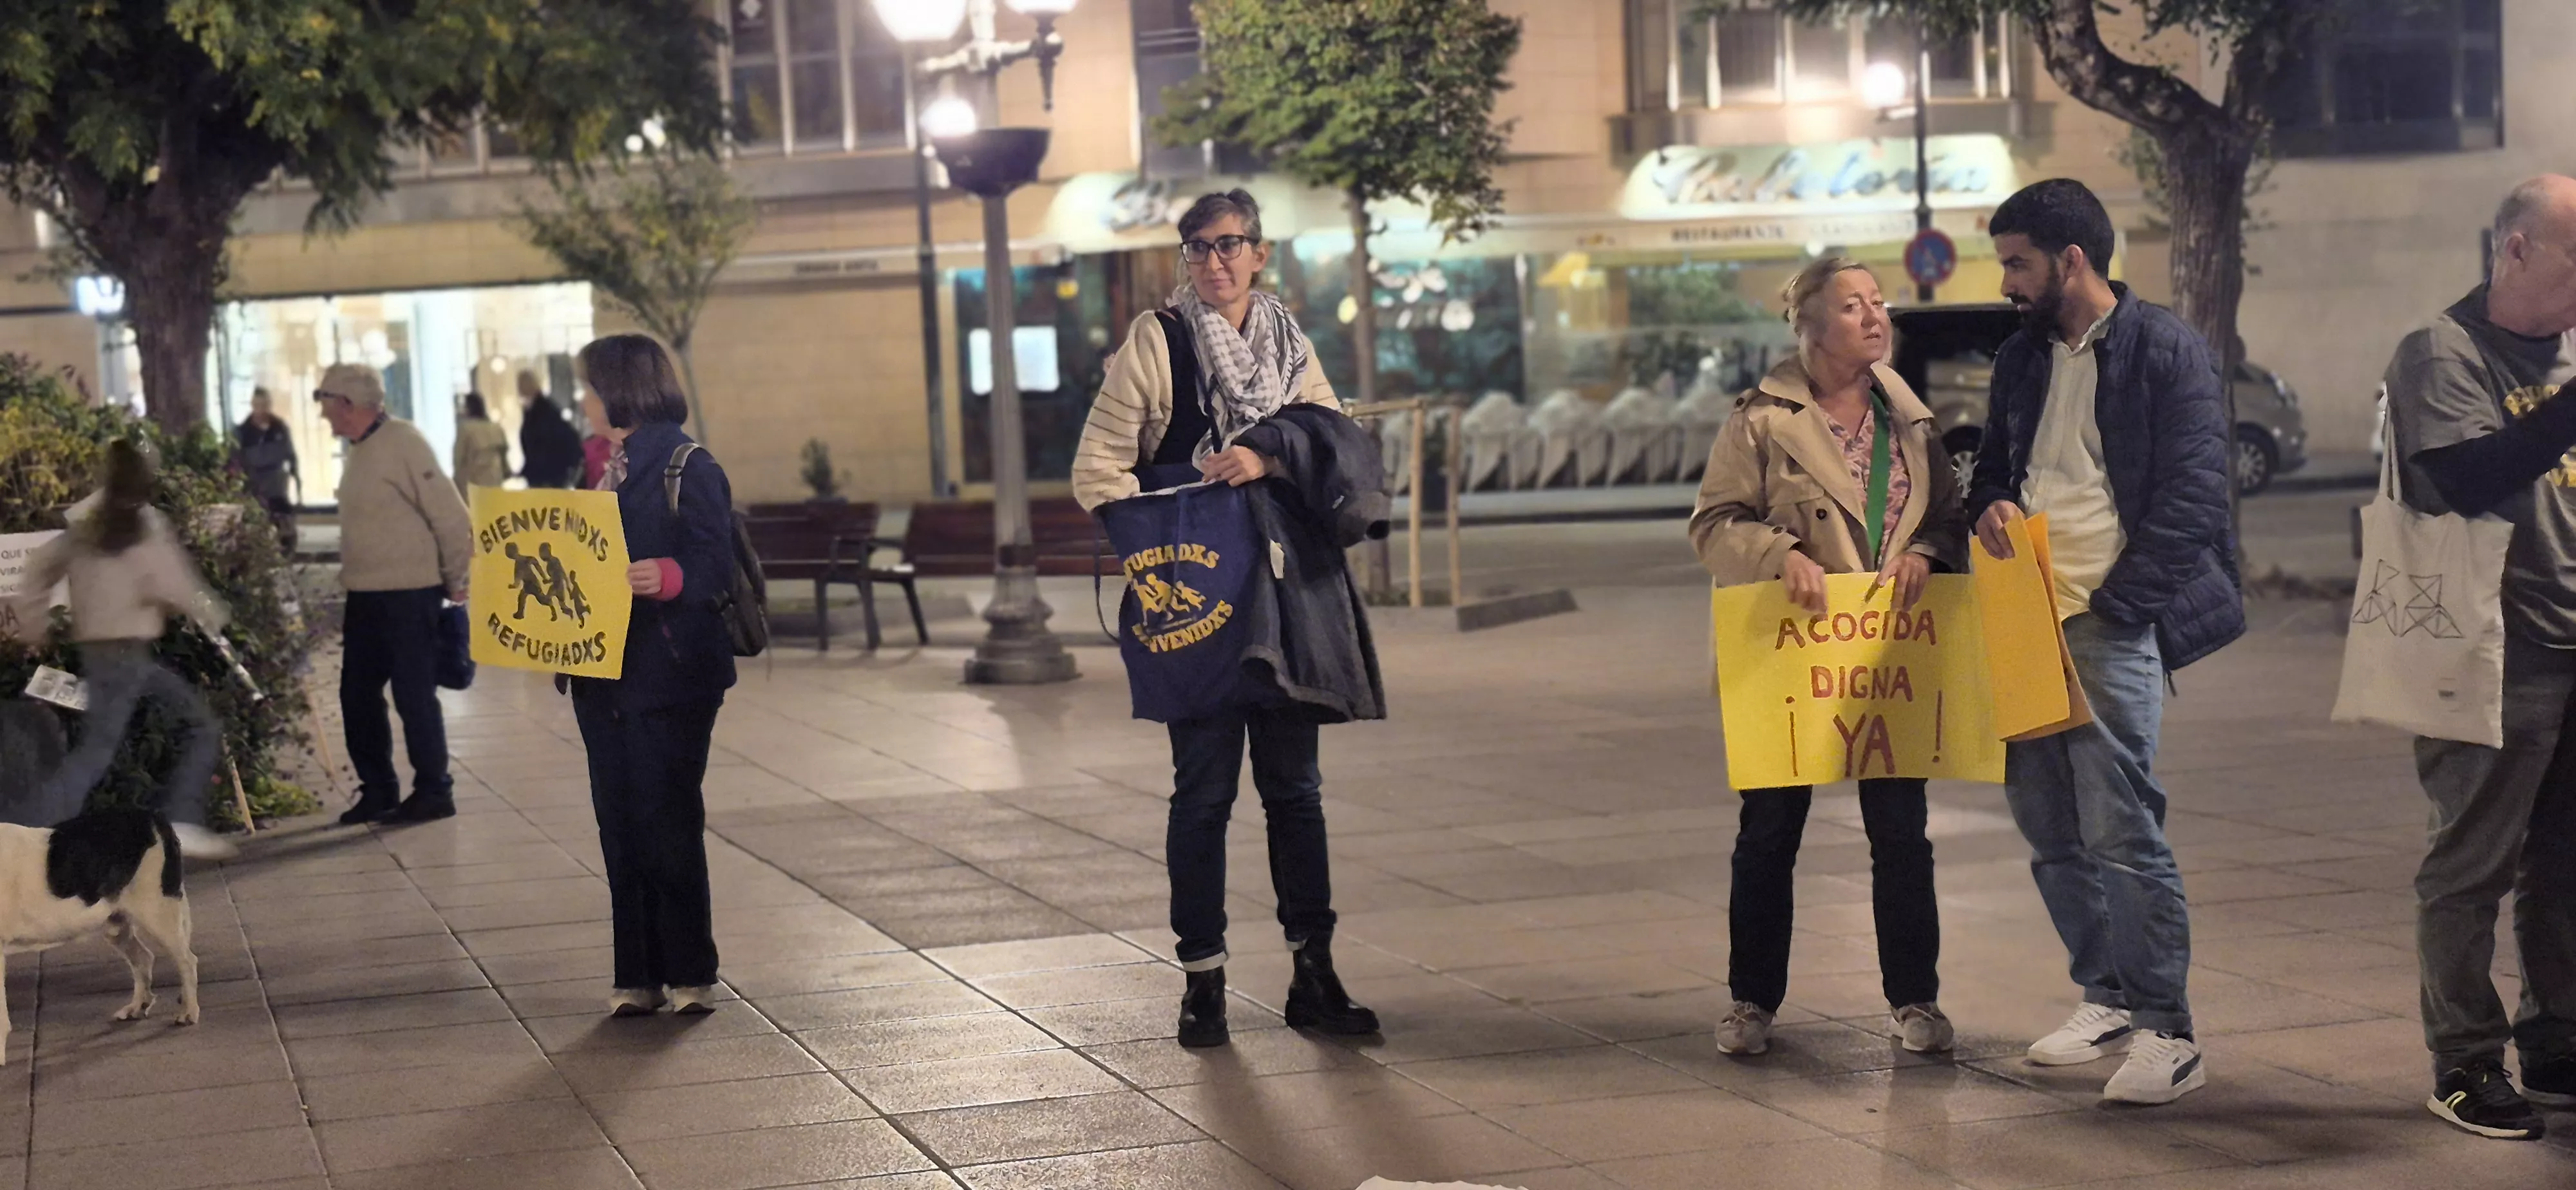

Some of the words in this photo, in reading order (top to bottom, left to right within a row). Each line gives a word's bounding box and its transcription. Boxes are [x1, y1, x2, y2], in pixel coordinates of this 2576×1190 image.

[488, 612, 607, 666] REFUGIADXS
[1774, 609, 1937, 651] ACOGIDA
[1810, 665, 1914, 703] DIGNA
